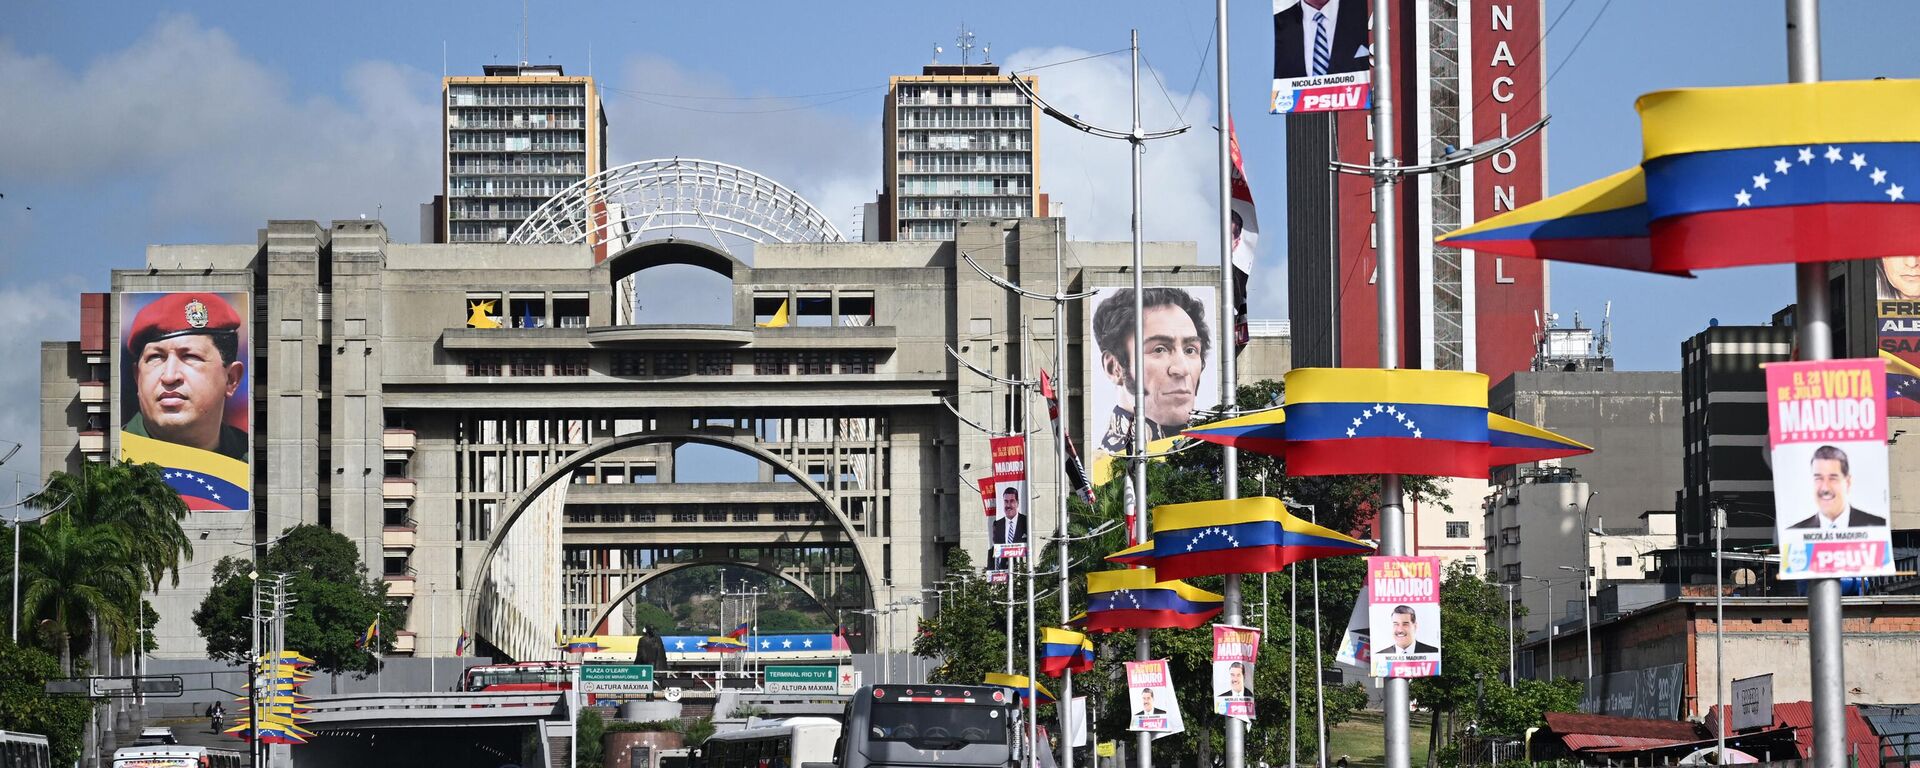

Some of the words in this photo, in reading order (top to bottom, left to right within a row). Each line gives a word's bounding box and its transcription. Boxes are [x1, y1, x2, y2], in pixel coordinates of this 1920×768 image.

[1291, 79, 1322, 88] NICOLÁS
[1323, 75, 1355, 85] MADURO
[1491, 5, 1516, 284] NACIONL
[1822, 369, 1874, 399] VOTA
[1778, 386, 1791, 401] DE
[1778, 397, 1877, 433] MADURO
[1781, 430, 1875, 441] PRESIDENTE
[1803, 532, 1834, 541] NICOLÁS
[1836, 531, 1869, 540] MADURO
[1400, 561, 1432, 578] VOTA
[1375, 577, 1434, 597] MADURO
[1217, 642, 1253, 657] MADURO
